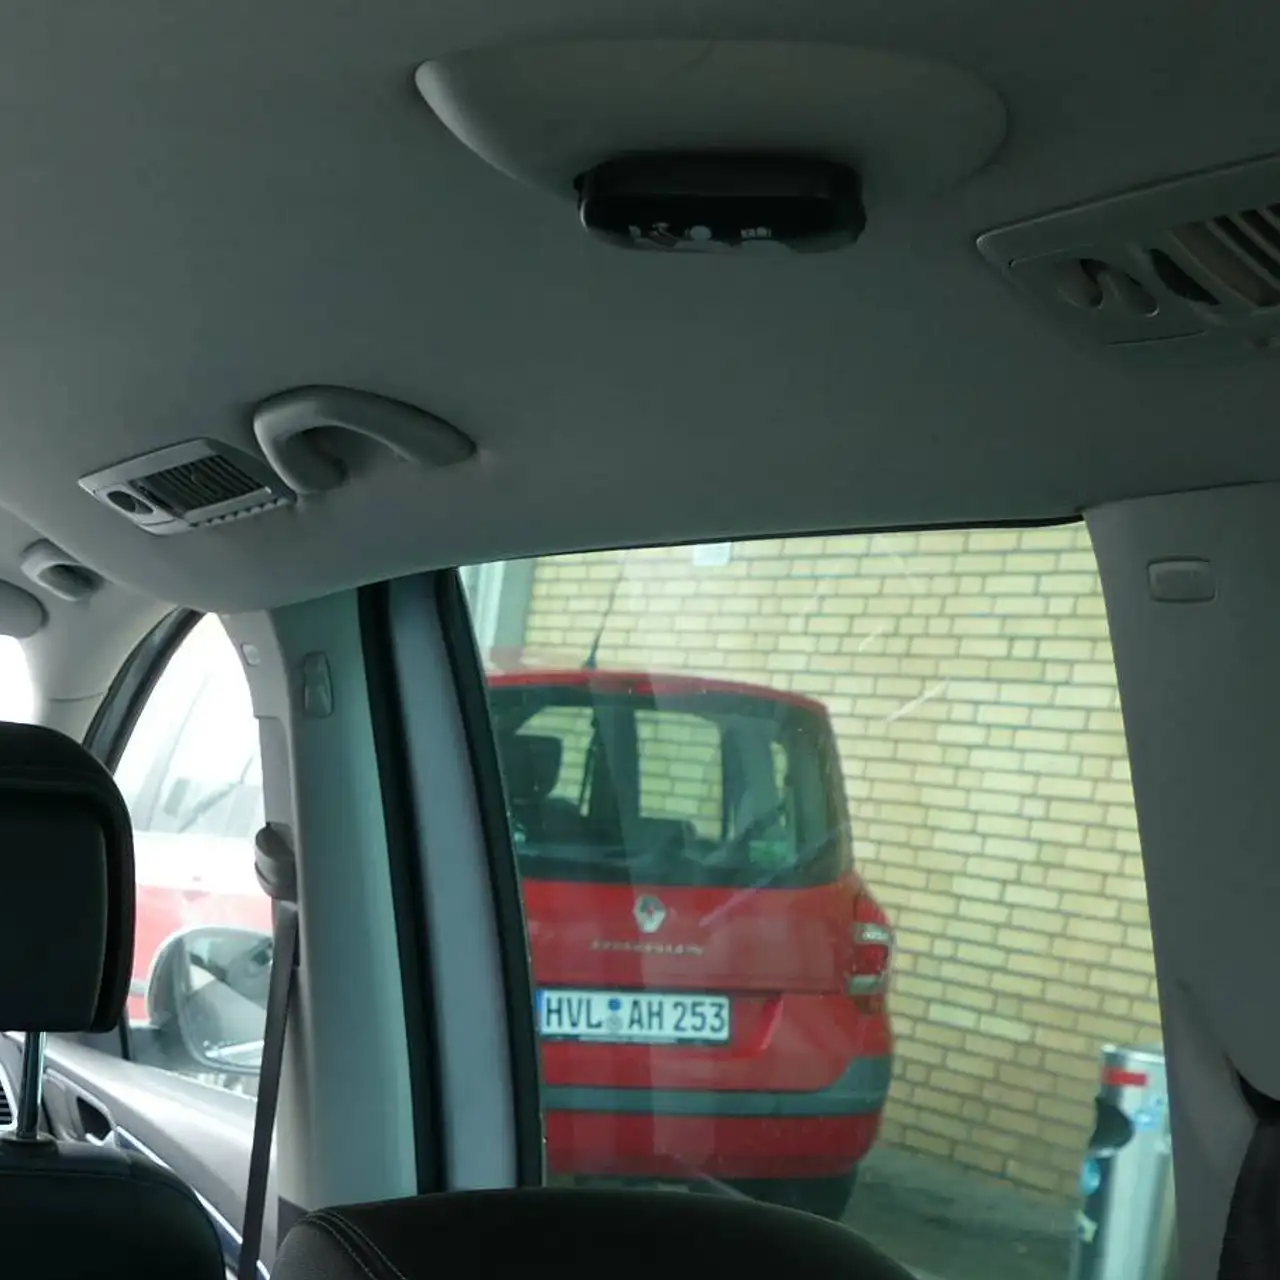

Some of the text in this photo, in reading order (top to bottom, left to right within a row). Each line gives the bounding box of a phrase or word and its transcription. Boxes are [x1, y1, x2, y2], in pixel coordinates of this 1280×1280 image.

[545, 996, 727, 1033] HVL AH 253
